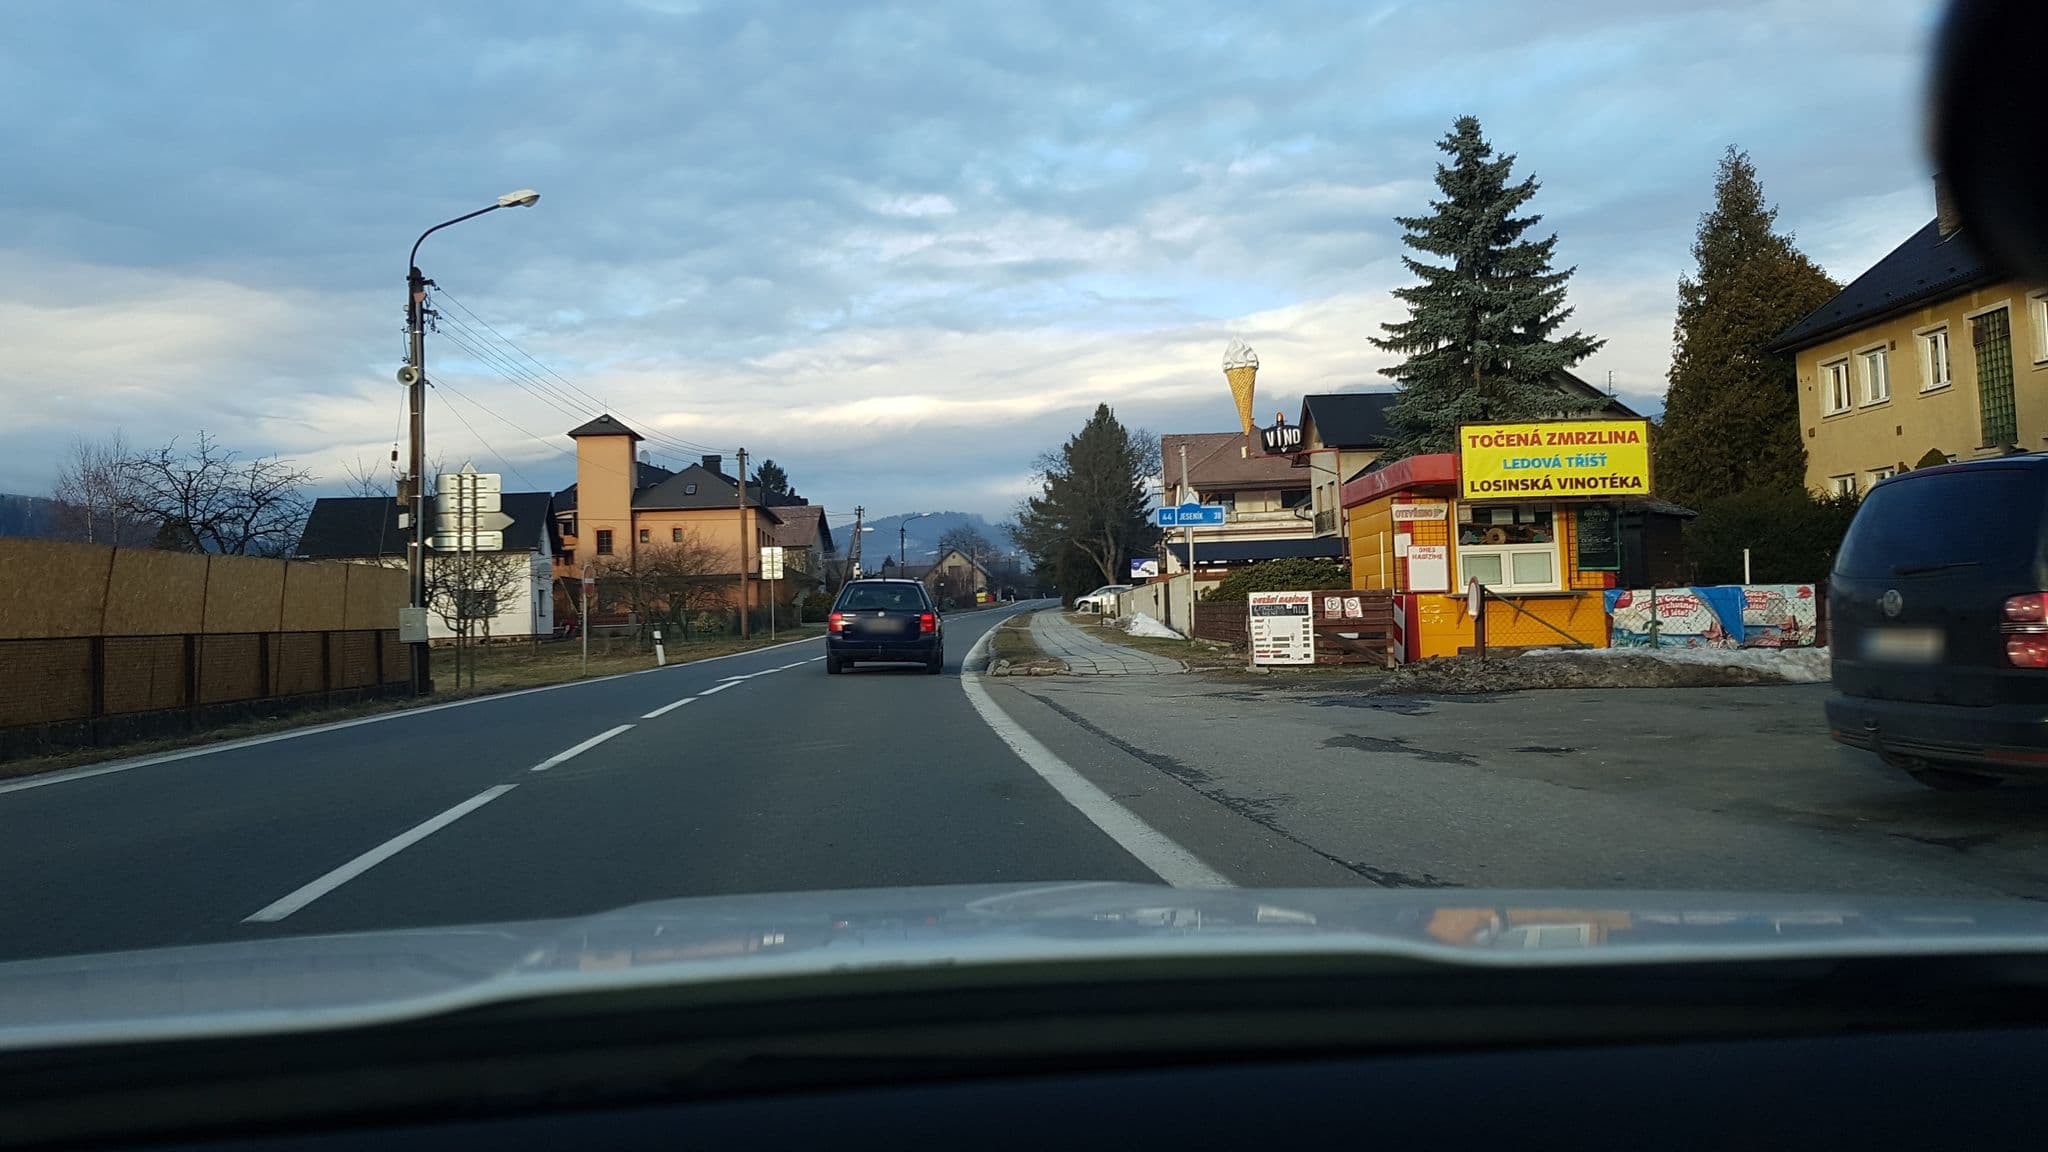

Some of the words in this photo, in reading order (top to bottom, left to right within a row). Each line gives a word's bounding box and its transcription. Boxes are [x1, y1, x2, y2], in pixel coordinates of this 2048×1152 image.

[1266, 427, 1301, 447] VÍNO
[1468, 429, 1542, 448] TOČENÁ
[1546, 430, 1640, 446] ZMRZLINA
[1503, 454, 1562, 470] LEDOVÁ
[1565, 453, 1608, 468] TŘÍŠŤ
[1470, 475, 1553, 493] LOSINSKÁ
[1557, 473, 1642, 490] VINOTÉKA
[1162, 512, 1173, 520] 44
[1180, 511, 1204, 521] JESENÍK
